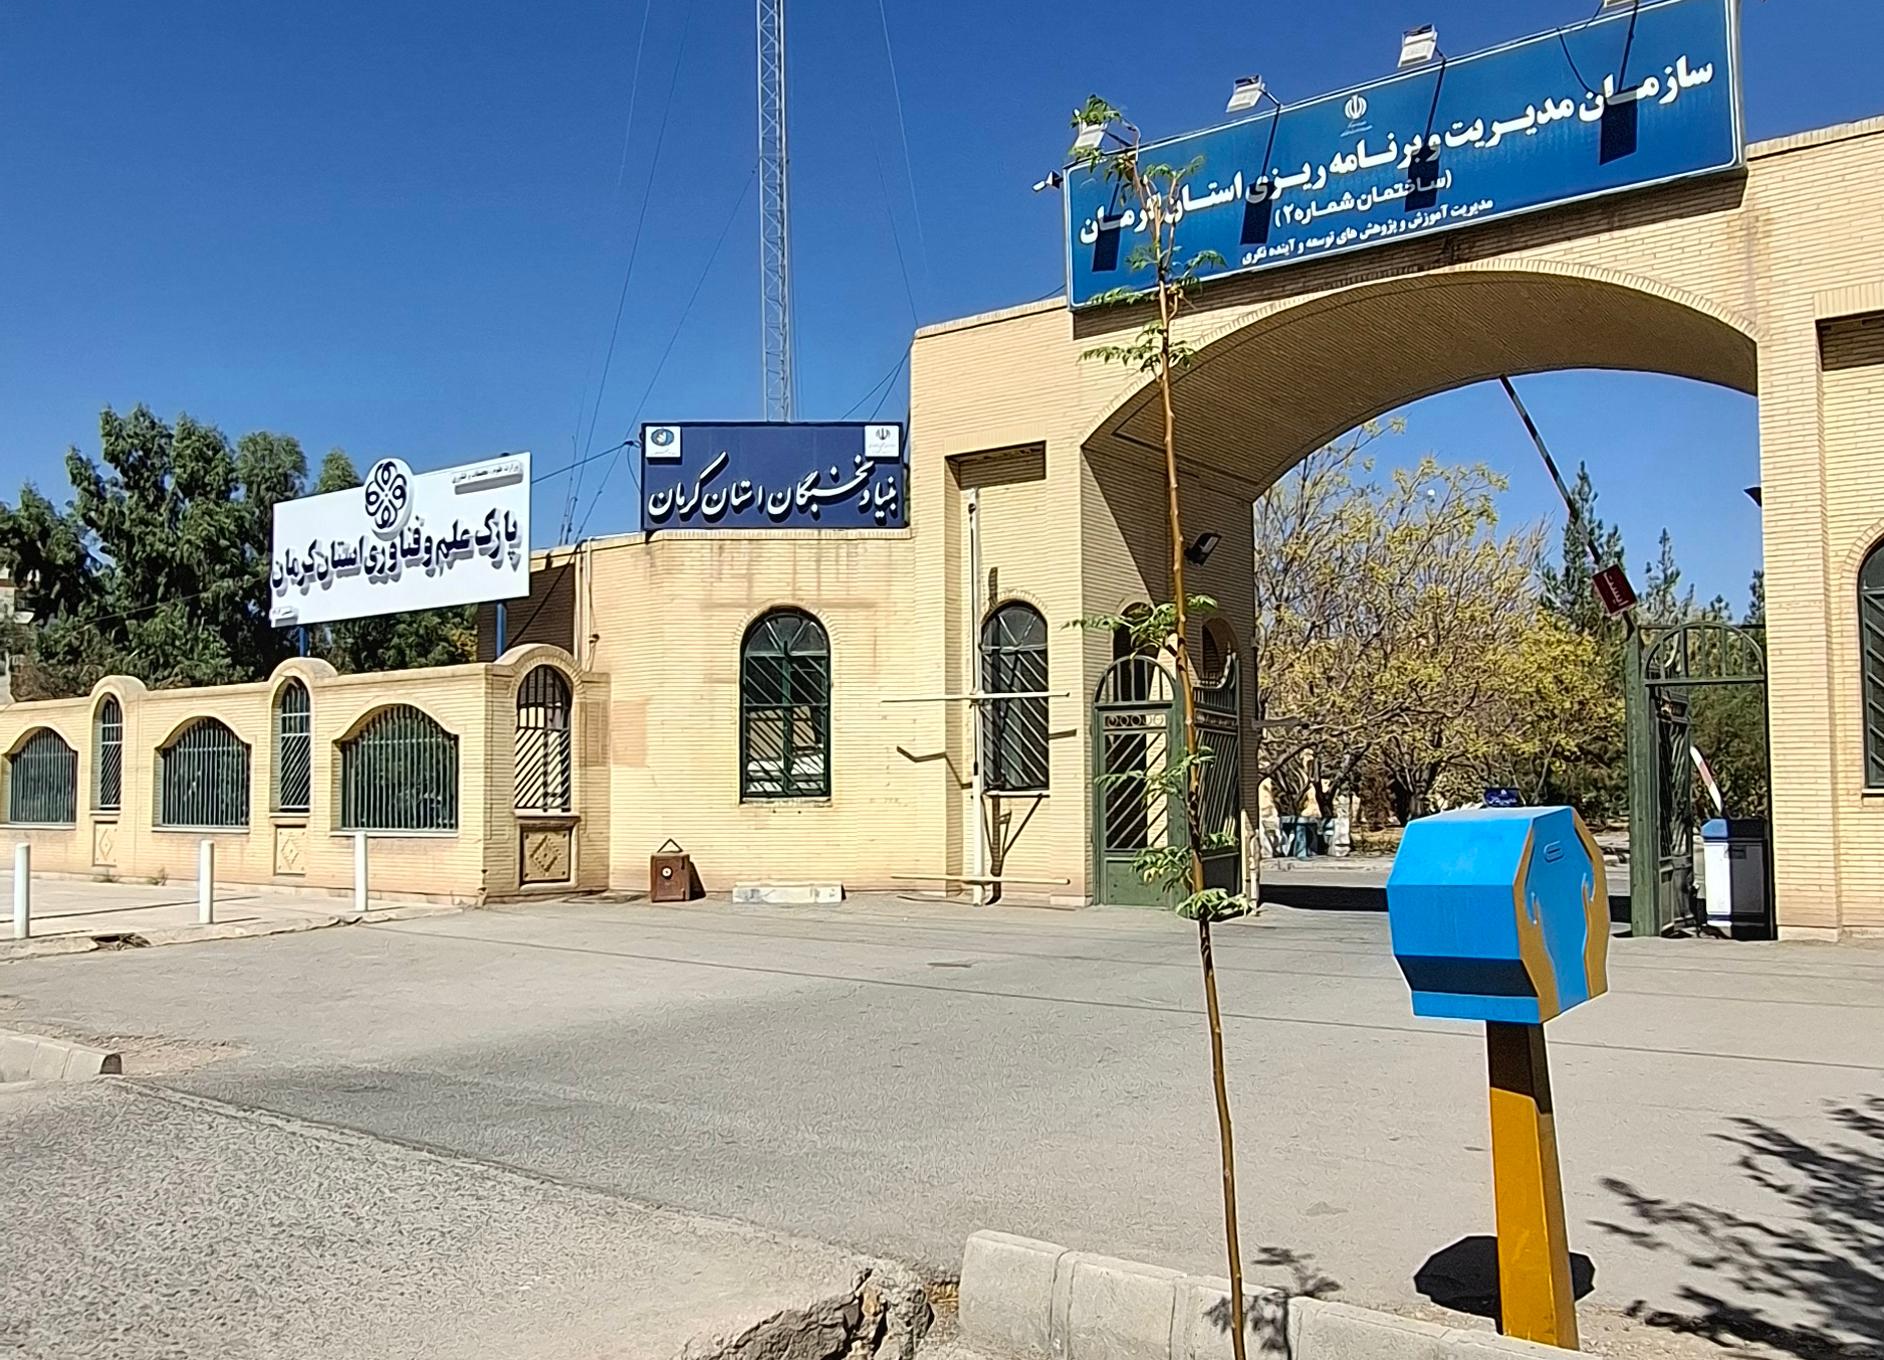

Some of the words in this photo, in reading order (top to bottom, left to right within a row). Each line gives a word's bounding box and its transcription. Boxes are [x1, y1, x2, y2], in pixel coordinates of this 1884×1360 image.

[1578, 55, 1714, 122] سازمان
[1445, 97, 1575, 148] مدیریت
[1329, 132, 1423, 173] برنامه
[1427, 134, 1442, 162] و
[1164, 171, 1242, 224] استان
[1246, 163, 1326, 203] ریزی
[1408, 204, 1448, 229] آموزش
[1450, 199, 1494, 217] مدیریت
[1268, 238, 1296, 256] آینده
[1298, 242, 1305, 255] و
[1305, 231, 1335, 248] توسعه
[1336, 226, 1358, 245] های
[1359, 219, 1398, 240] پژوهش
[649, 451, 727, 516] کرمان
[701, 480, 763, 516] استان
[767, 454, 875, 515] نخبگان
[858, 476, 898, 518] بنیاد
[364, 515, 421, 575] فناوری
[421, 536, 434, 568] و
[436, 519, 471, 566] علم
[475, 508, 517, 560] پارک
[271, 539, 317, 589] کرمان
[317, 535, 364, 582] استان
[1602, 571, 1629, 607] ایست
